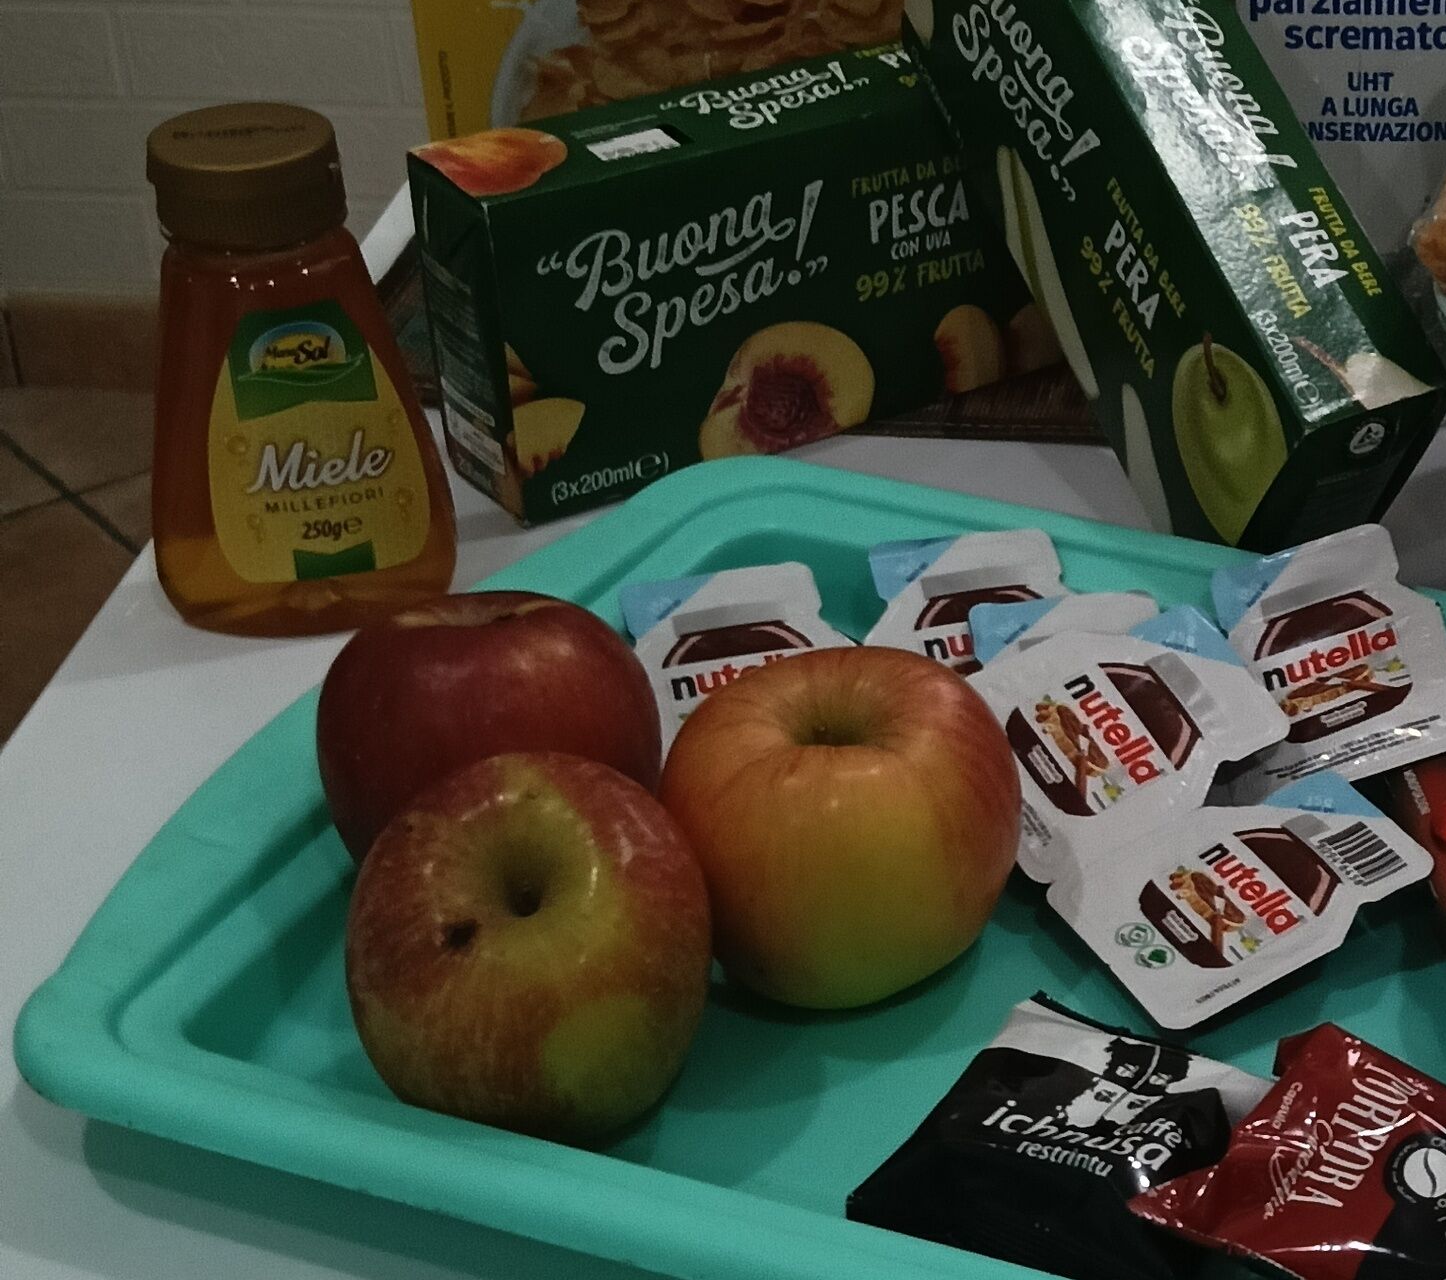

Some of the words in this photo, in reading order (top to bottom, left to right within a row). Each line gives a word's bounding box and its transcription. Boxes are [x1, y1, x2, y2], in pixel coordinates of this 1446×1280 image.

[1321, 97, 1338, 117] A
[1343, 97, 1419, 118] LUNGA
[1347, 71, 1394, 93] UHT
[852, 166, 910, 199] FRUTTA
[916, 159, 937, 181] DA
[868, 178, 970, 245] PESCA
[890, 236, 920, 261] CON
[925, 229, 952, 252] UVA
[1103, 219, 1161, 330] PERA
[1107, 177, 1145, 244] FRUTTA
[1143, 243, 1160, 271] DA
[1158, 270, 1187, 318] BERE
[1279, 210, 1349, 289] PERA
[1308, 186, 1348, 237] FRUTTA
[1340, 238, 1362, 263] DA
[1351, 261, 1383, 297] BERE
[855, 264, 907, 303] 99%
[916, 248, 985, 288] FRUTTA
[1081, 235, 1115, 294] 99%
[1112, 296, 1156, 380] FRUTTA
[1261, 254, 1313, 320] FRUTTA
[247, 429, 393, 494] Miele
[265, 486, 385, 514] MILLEFIORI
[1262, 627, 1398, 692] nutella
[1063, 673, 1162, 786] nutella
[1198, 842, 1300, 936] nutella
[982, 1099, 1173, 1171] ichnusa
[1016, 1140, 1114, 1177] restrintu
